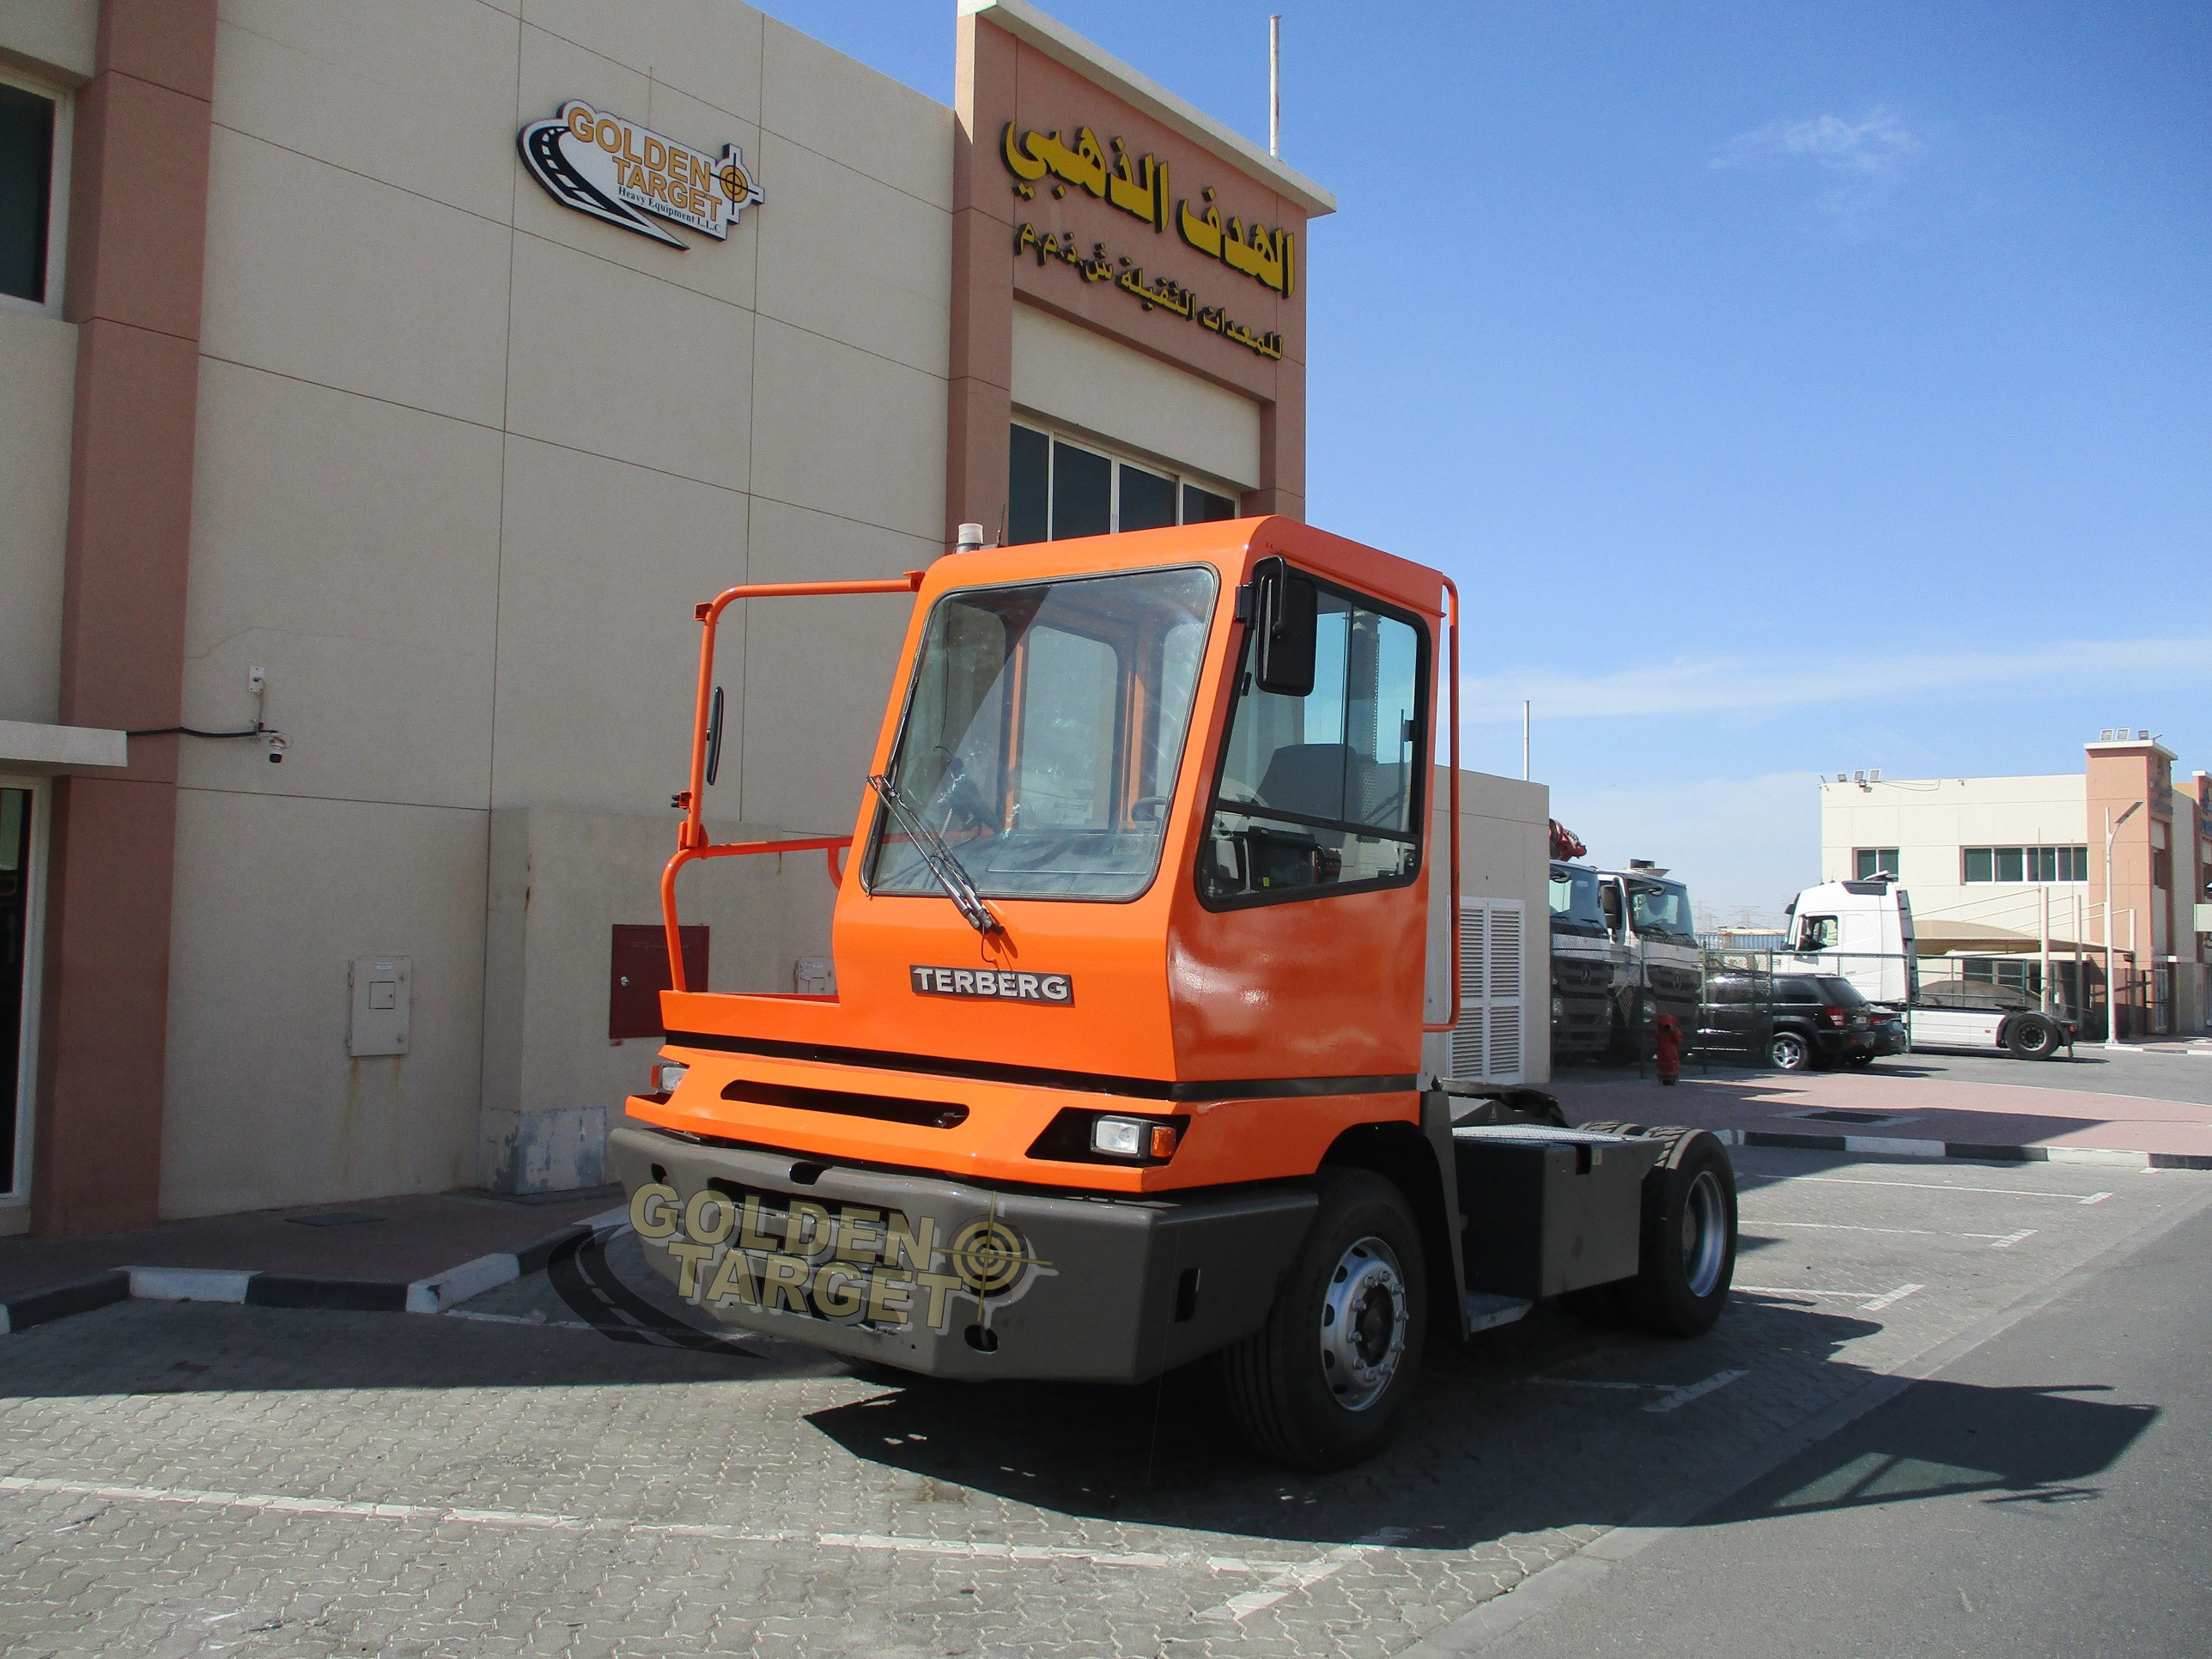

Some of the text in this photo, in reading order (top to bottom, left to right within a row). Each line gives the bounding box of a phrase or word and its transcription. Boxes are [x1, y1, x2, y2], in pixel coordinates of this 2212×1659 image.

[568, 106, 711, 192] GOLDEN
[612, 155, 722, 222] TARGET
[618, 185, 647, 205] Heavy
[648, 198, 695, 224] Equipment
[1000, 120, 1295, 299] الهدف الذهبي
[913, 968, 1069, 1000] TERBERG
